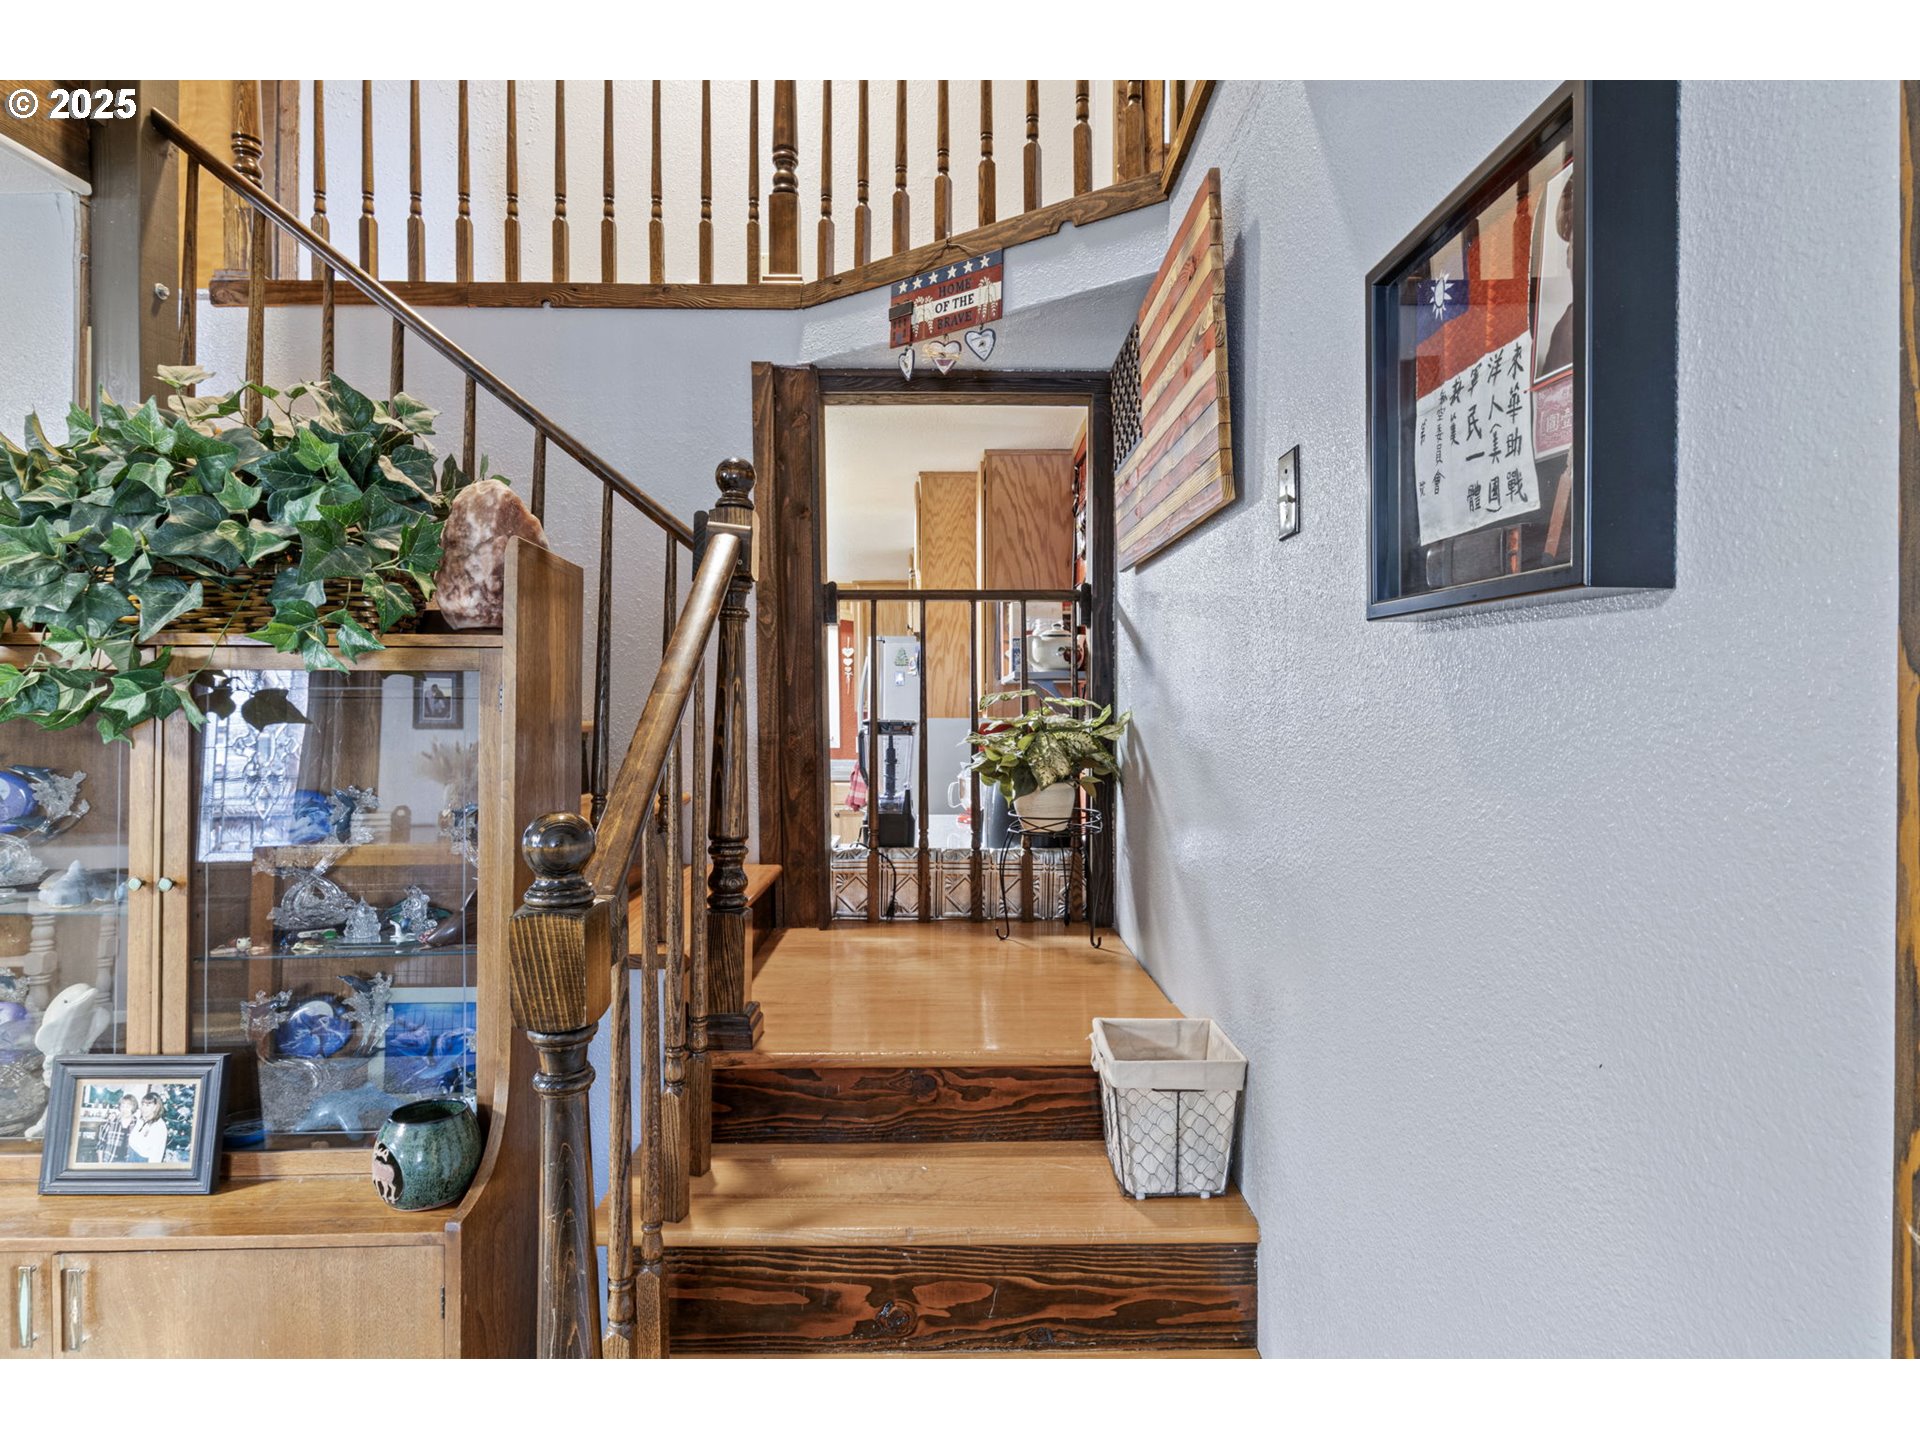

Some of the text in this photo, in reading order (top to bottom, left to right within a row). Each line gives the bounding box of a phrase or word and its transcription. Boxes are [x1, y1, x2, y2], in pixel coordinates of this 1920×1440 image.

[939, 278, 972, 297] HOME
[935, 293, 974, 313] OF THE
[937, 311, 973, 330] BRAVE
